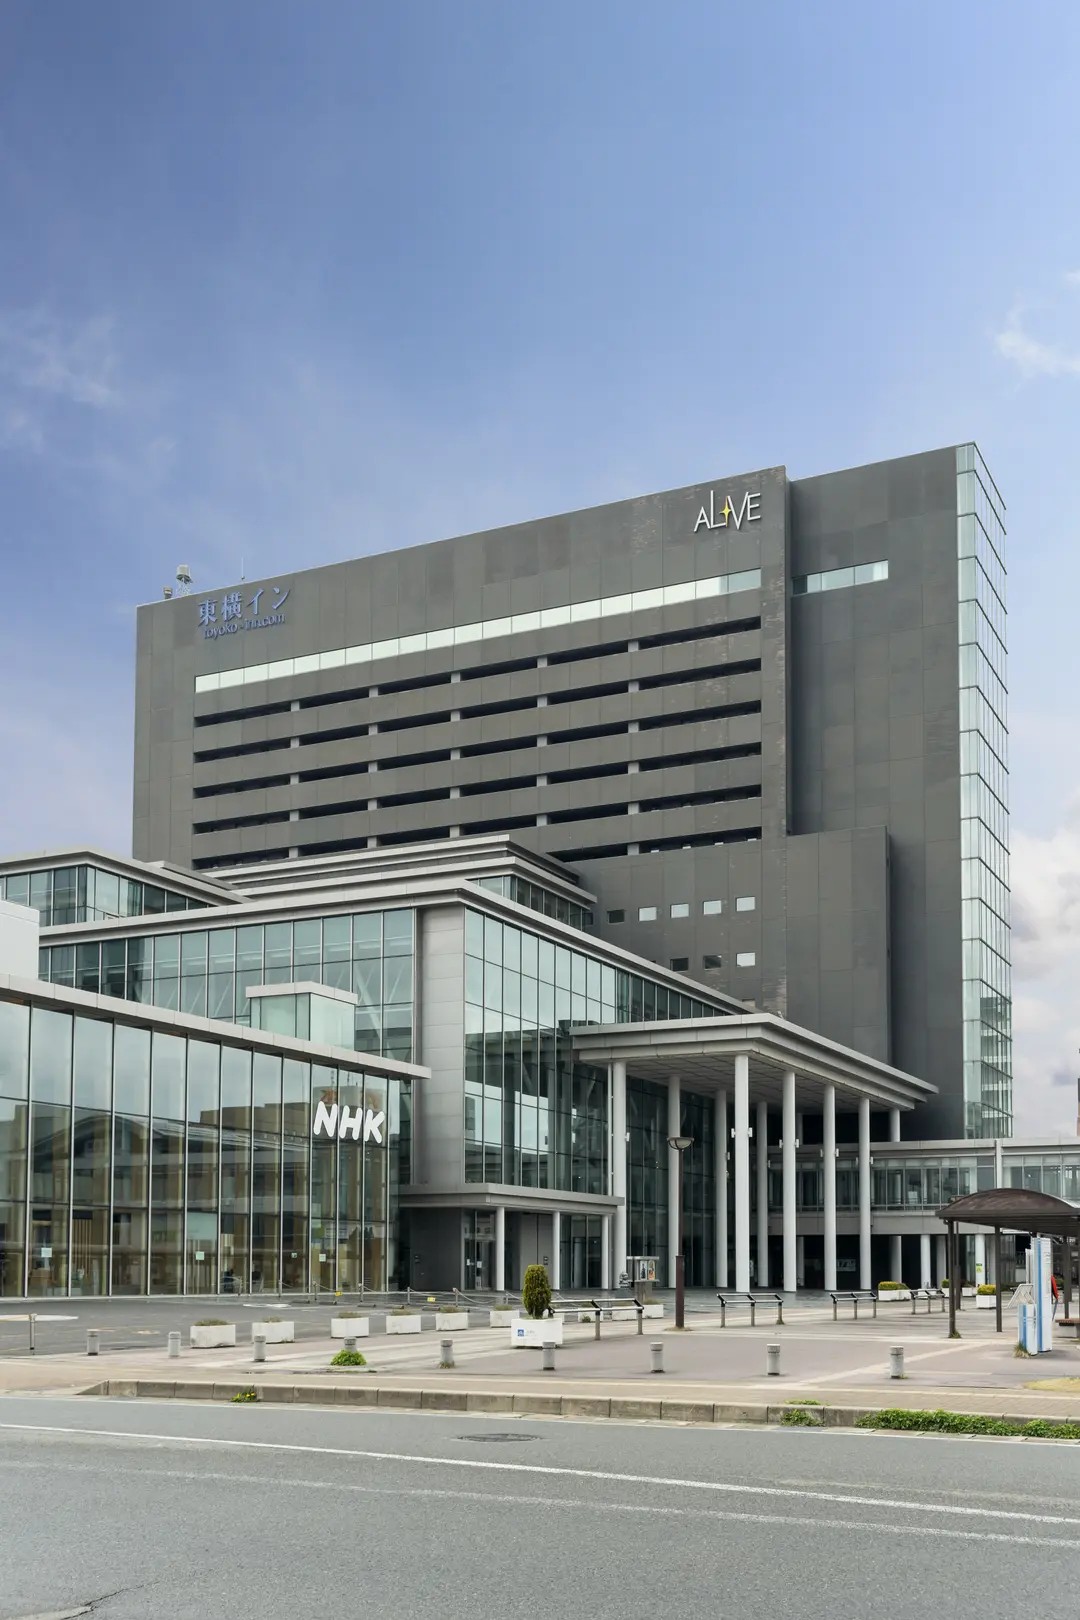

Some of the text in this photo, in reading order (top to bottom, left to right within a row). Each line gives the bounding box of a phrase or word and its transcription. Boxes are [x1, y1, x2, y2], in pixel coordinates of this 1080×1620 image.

[198, 586, 291, 626] 東横イン
[313, 1101, 385, 1143] NHK
